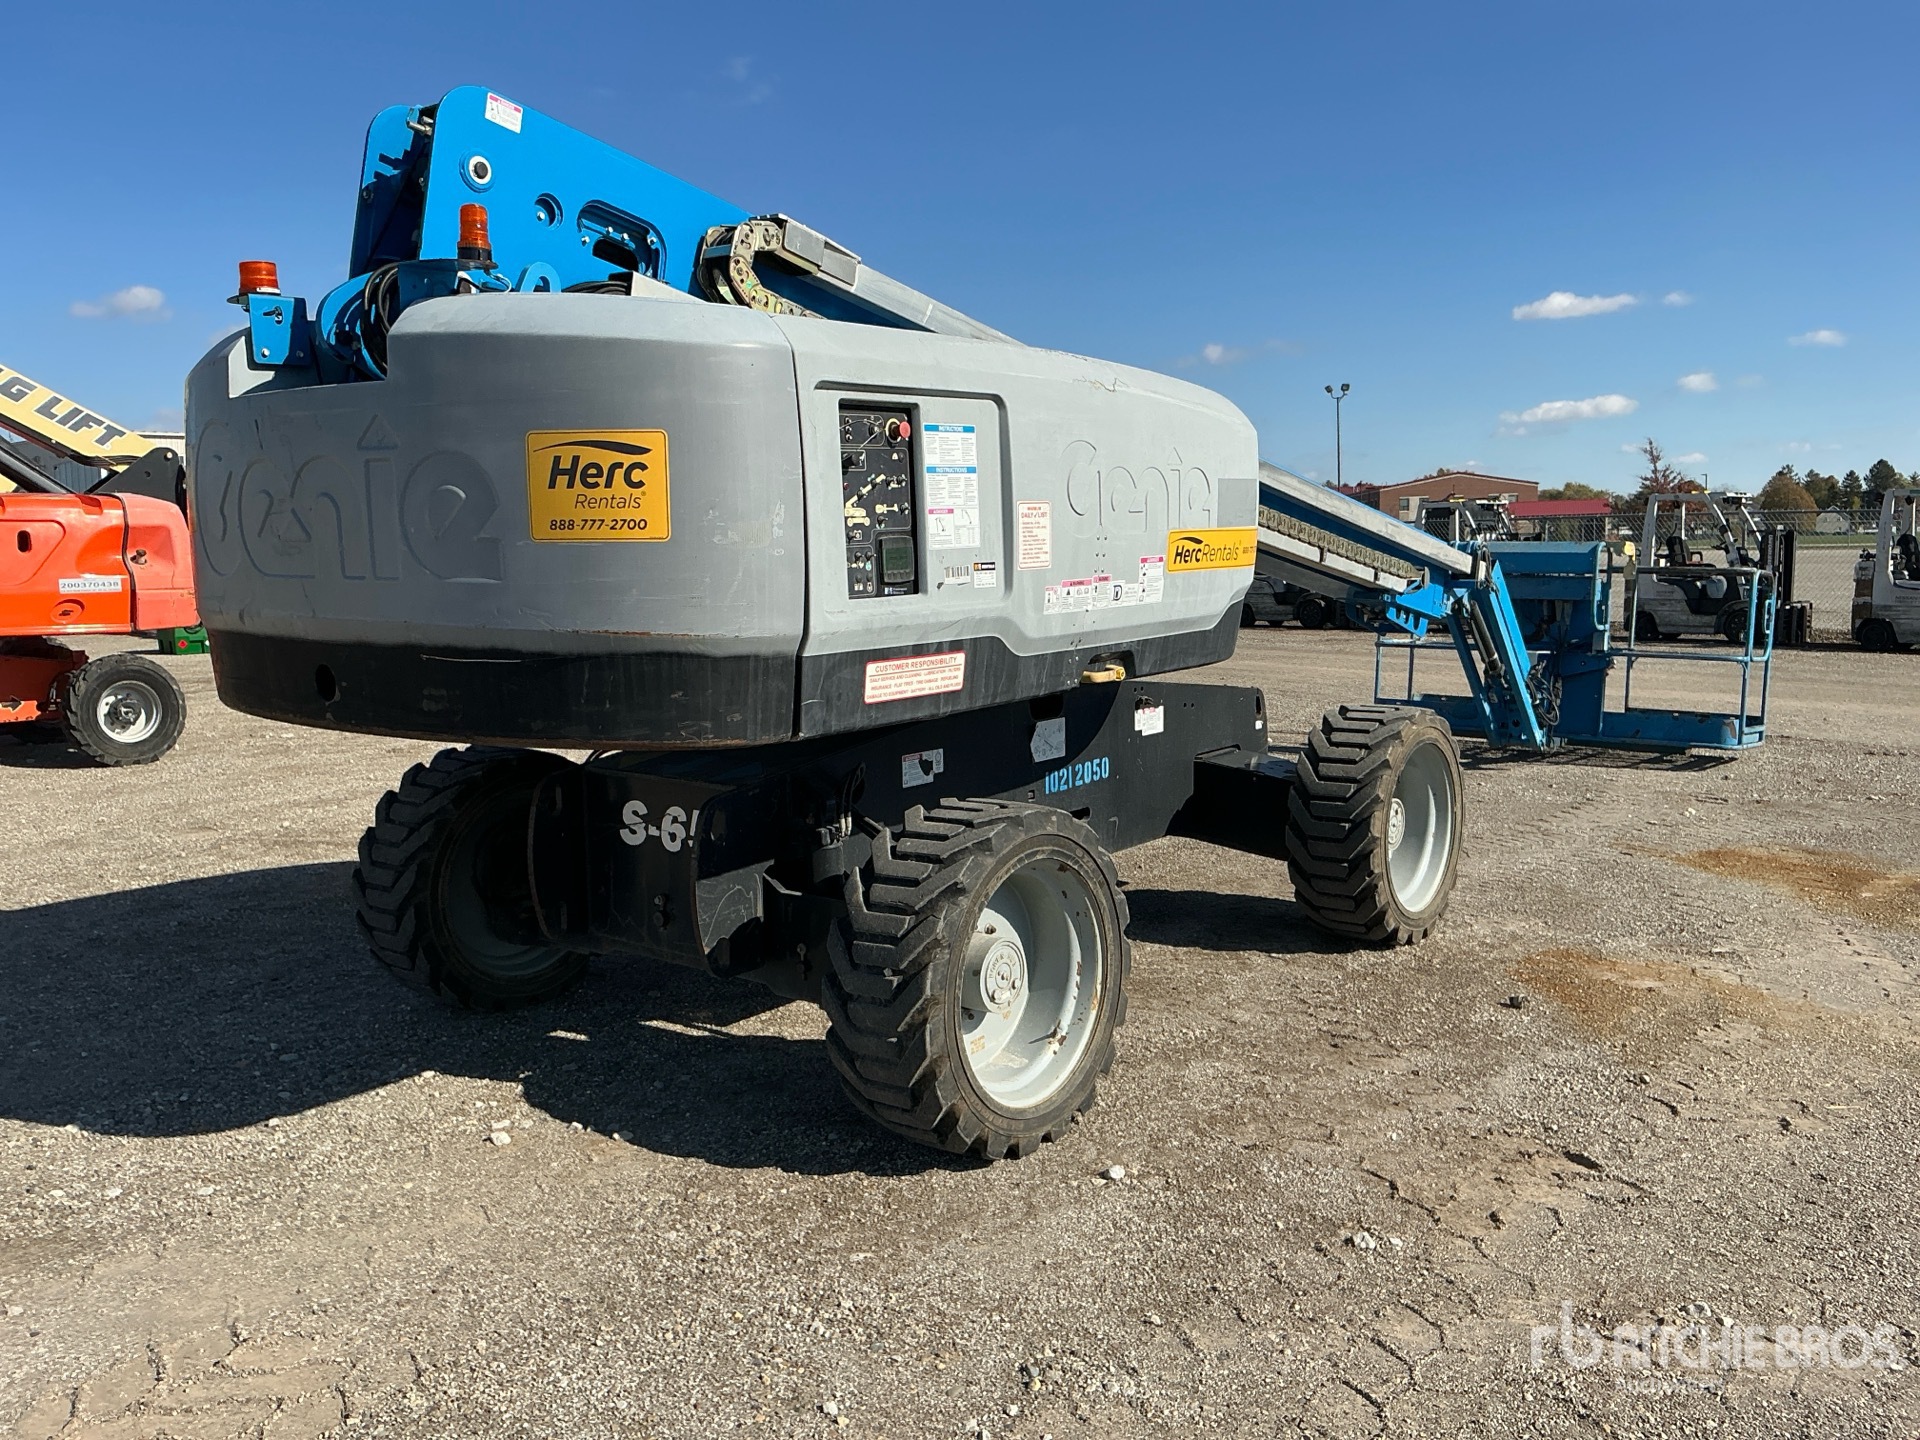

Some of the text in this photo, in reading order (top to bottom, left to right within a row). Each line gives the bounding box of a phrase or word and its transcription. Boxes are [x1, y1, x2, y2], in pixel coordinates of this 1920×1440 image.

[0, 368, 127, 446] G LIFT
[548, 455, 649, 490] Herc
[549, 518, 648, 531] 888-777-2700
[875, 657, 957, 673] CUSTOMER RESPONSIBILITY
[1045, 756, 1110, 794] 10212050
